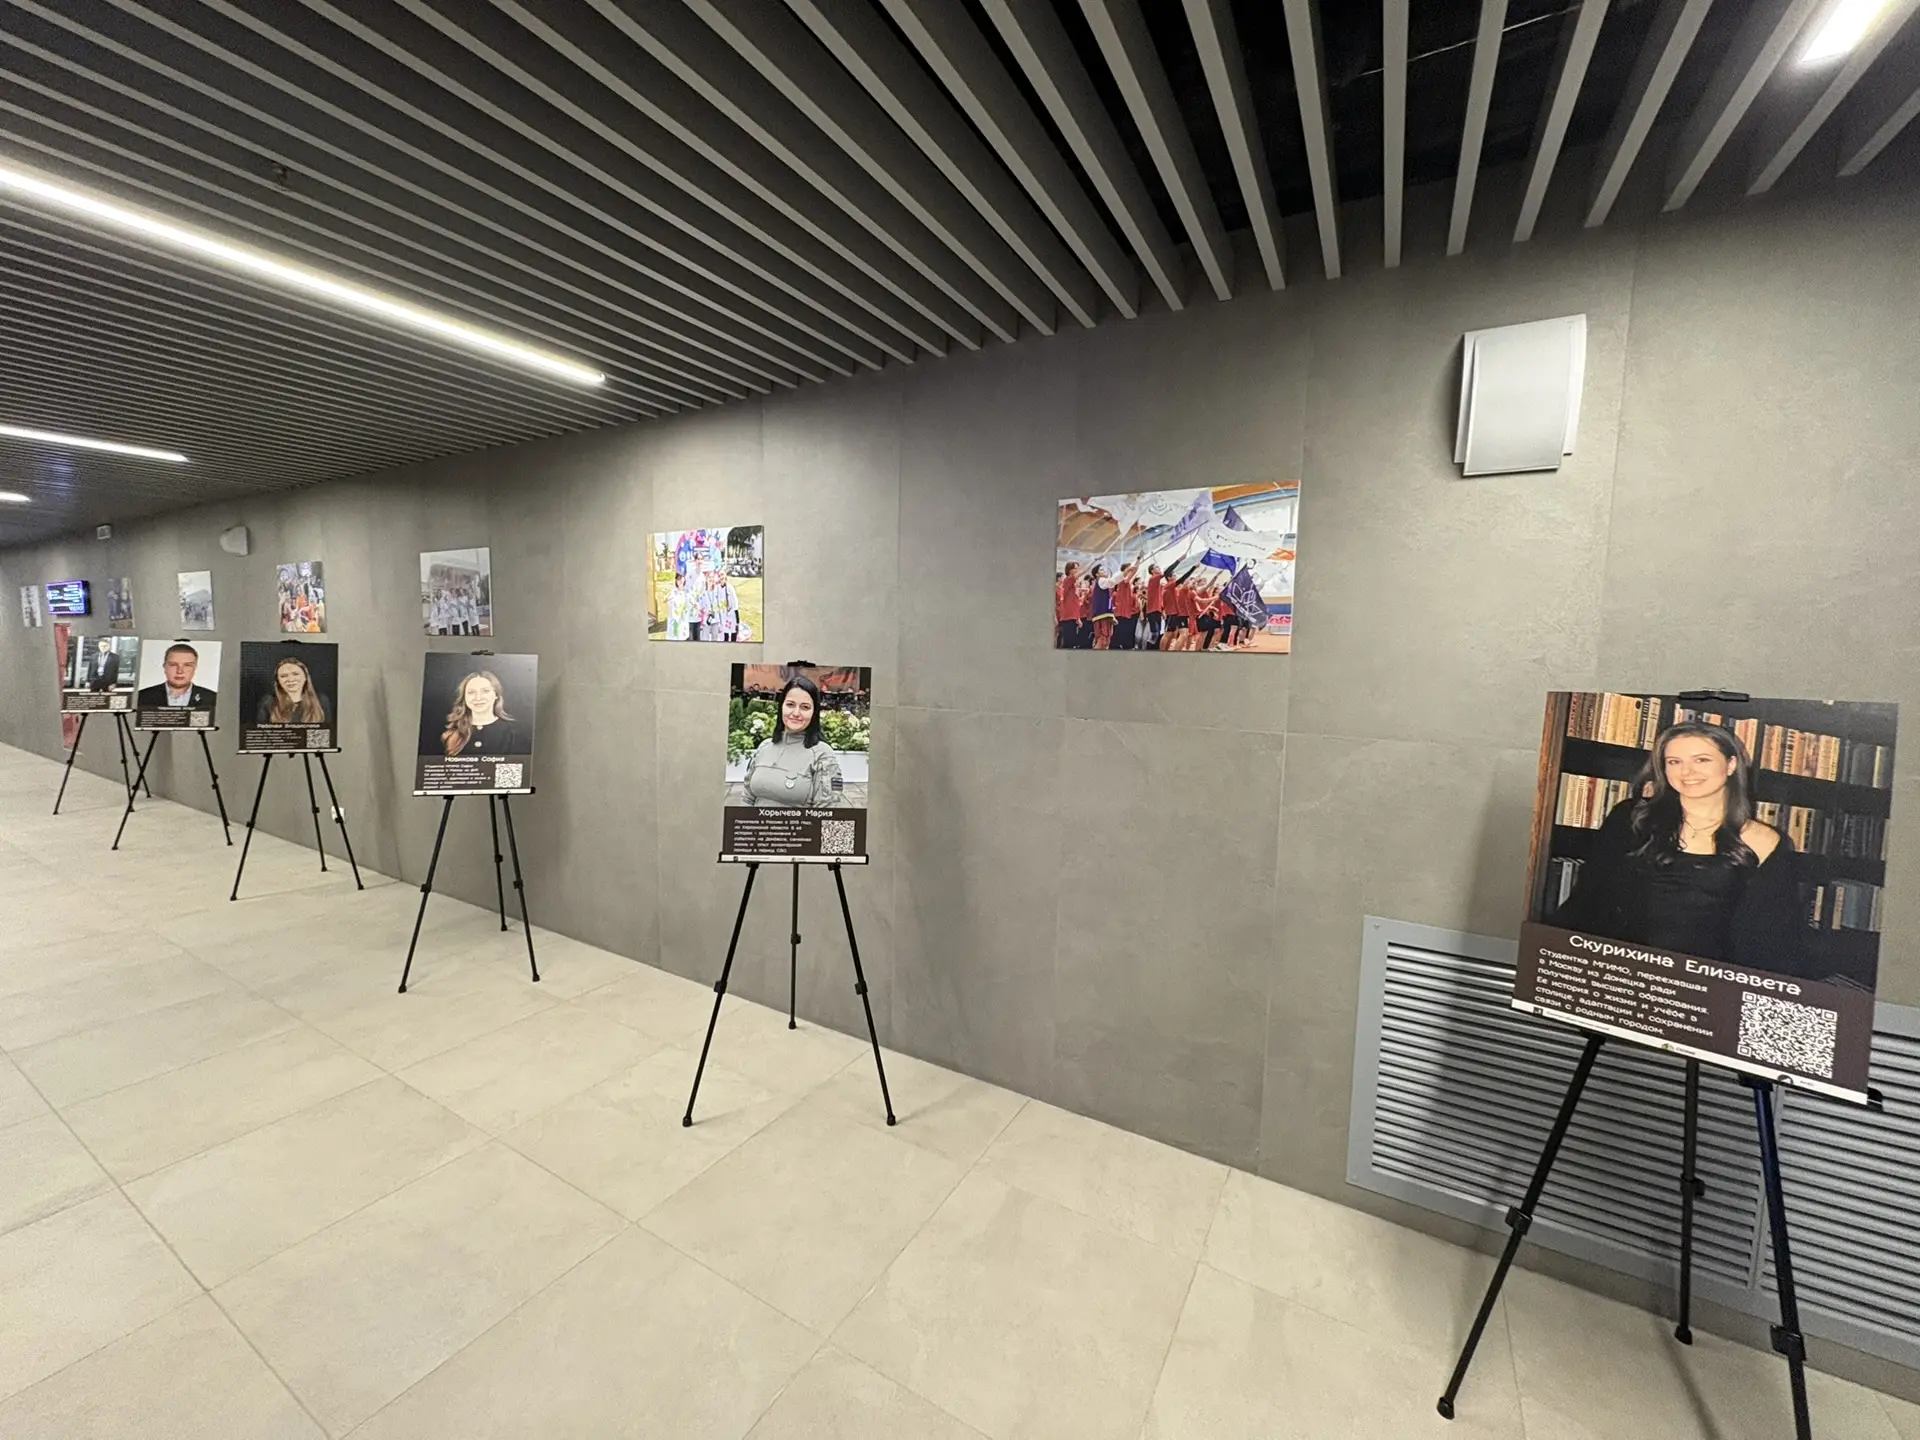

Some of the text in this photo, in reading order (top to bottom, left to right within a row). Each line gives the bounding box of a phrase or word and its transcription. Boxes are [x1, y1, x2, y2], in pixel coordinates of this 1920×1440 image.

[805, 809, 833, 818] Мария
[1539, 948, 1708, 993] Студентка МГИМО, переехавшая
[1548, 960, 1584, 974] Москву
[1587, 970, 1600, 978] из
[1603, 973, 1646, 988] Донецка
[1650, 985, 1676, 995] ради
[1569, 935, 1802, 995] Скурихина Елизавета
[1535, 986, 1575, 1002] столице,
[1579, 997, 1633, 1016] адаптации
[1648, 1015, 1713, 1037] сохранении
[1536, 976, 1548, 984] Ее
[1551, 981, 1589, 995] история
[1604, 993, 1637, 1007] жизни
[1653, 1006, 1685, 1020] учёбе
[1537, 967, 1709, 1014] получения высшего образования.
[1534, 995, 1562, 1007] связи
[1575, 1006, 1615, 1021] родным
[1618, 1017, 1665, 1036] городом.
